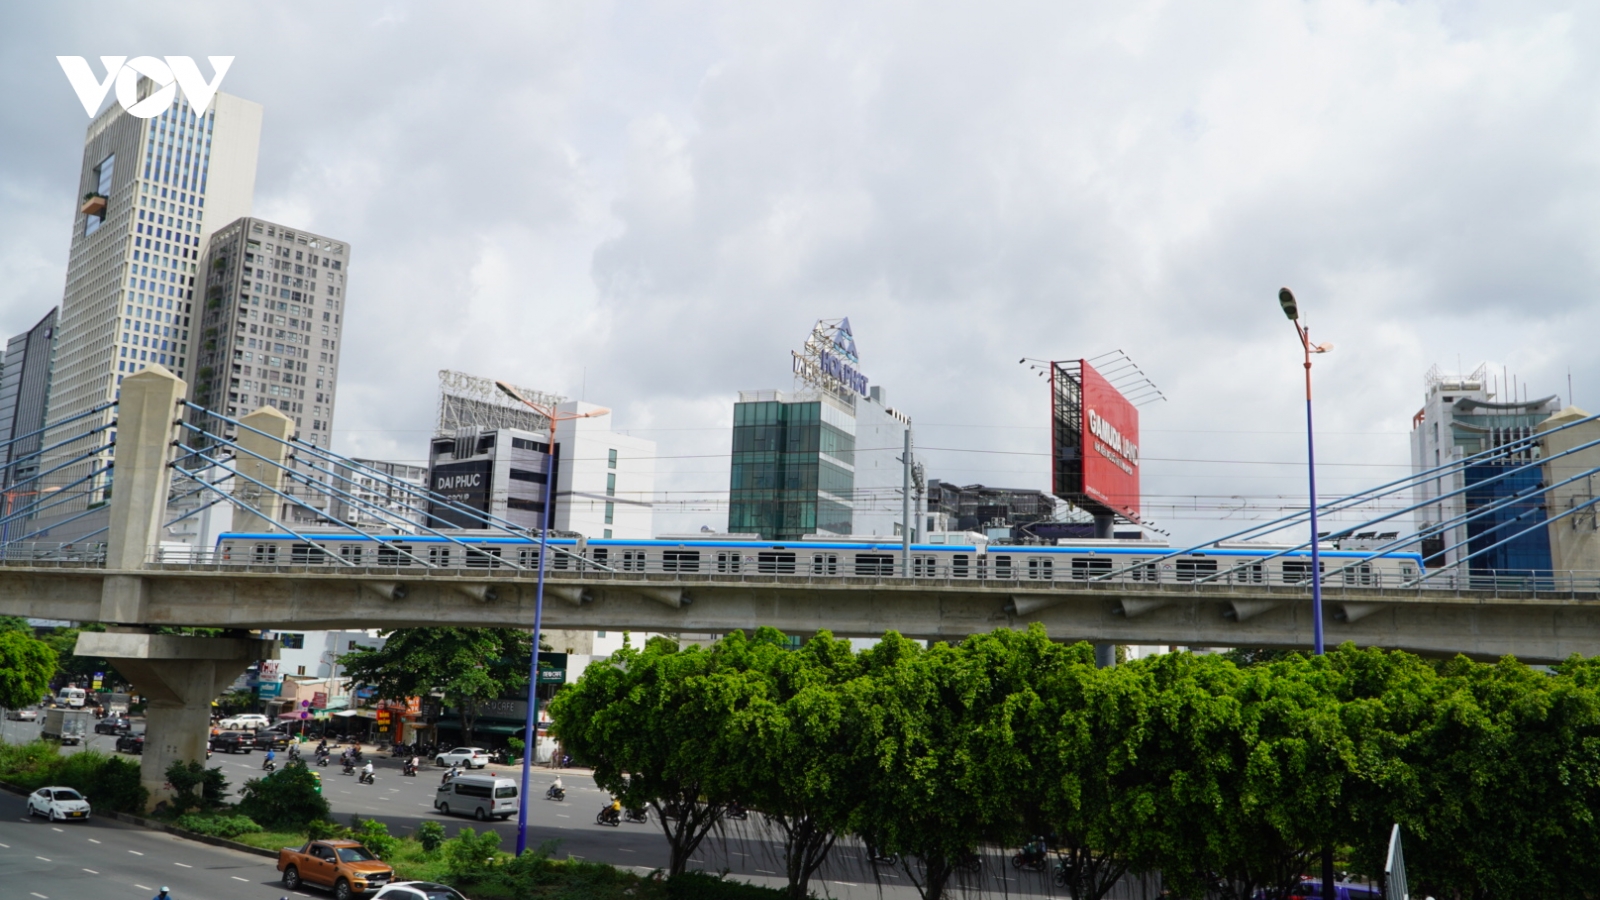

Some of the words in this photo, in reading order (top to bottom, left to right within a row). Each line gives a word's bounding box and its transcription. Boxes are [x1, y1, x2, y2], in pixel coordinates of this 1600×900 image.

[1088, 408, 1121, 454] GAMUDA
[1121, 435, 1138, 467] LAND
[455, 473, 480, 488] PHUC
[498, 701, 514, 711] CAFE
